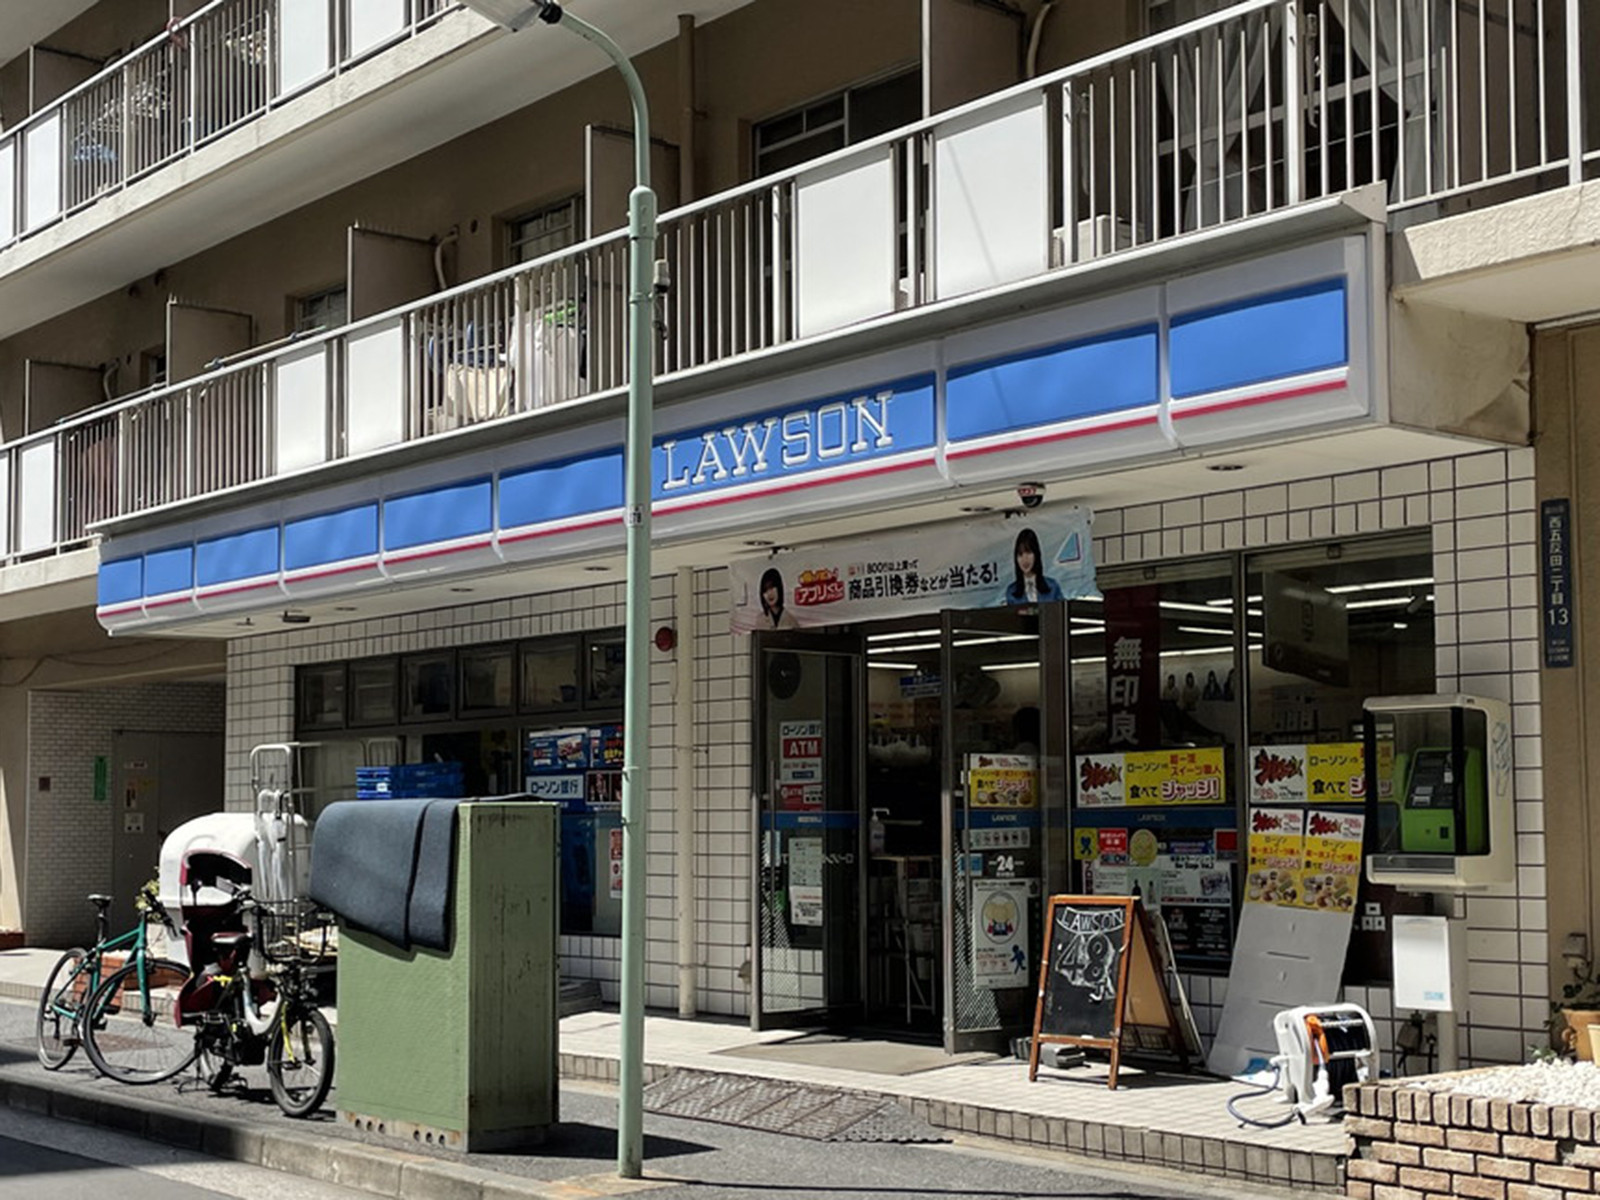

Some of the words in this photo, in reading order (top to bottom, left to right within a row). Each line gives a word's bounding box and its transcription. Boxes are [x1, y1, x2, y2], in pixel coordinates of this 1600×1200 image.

[662, 391, 893, 490] LAWSON
[1548, 608, 1568, 625] 13
[789, 740, 819, 757] ATM
[996, 855, 1014, 872] 24
[1062, 909, 1123, 932] LAWSON
[1056, 932, 1110, 984] 48
